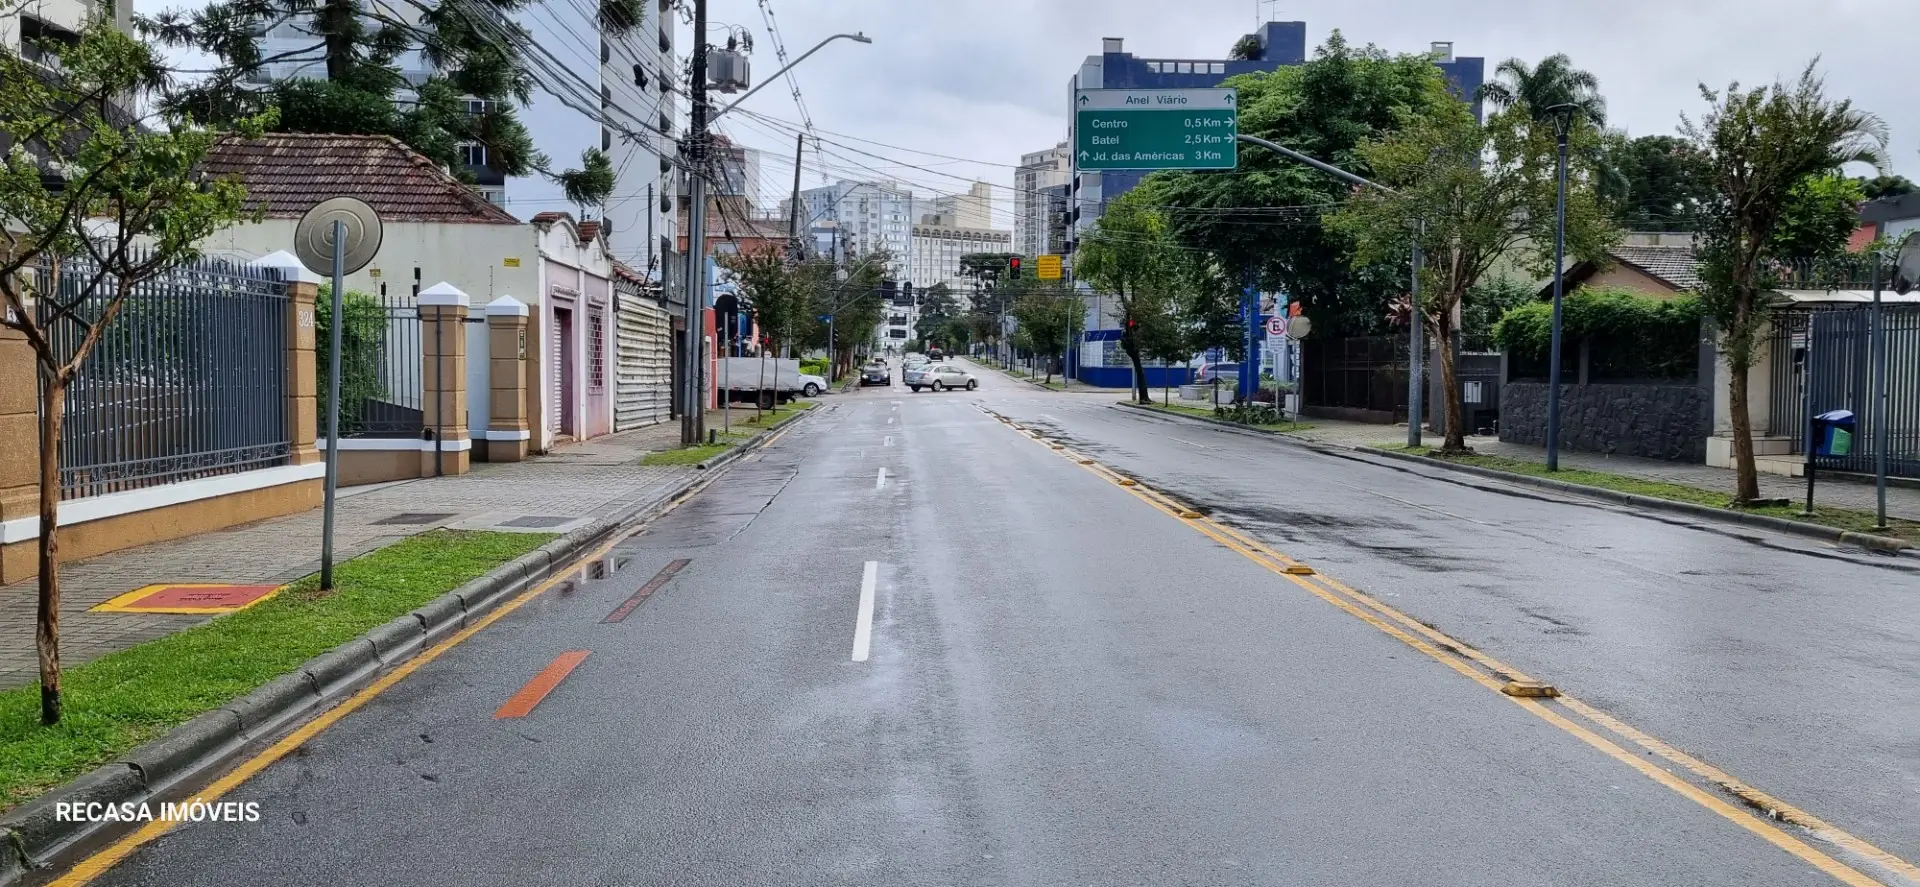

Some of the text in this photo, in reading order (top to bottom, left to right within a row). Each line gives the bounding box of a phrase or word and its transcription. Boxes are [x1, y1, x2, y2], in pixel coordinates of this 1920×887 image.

[1126, 95, 1188, 104] Anel Viário
[1092, 118, 1221, 128] Centro 0,5 Km
[1092, 135, 1221, 144] Batel 2,5 Km
[1093, 151, 1221, 161] Jd. das Américas 3 Km
[299, 310, 313, 327] 324
